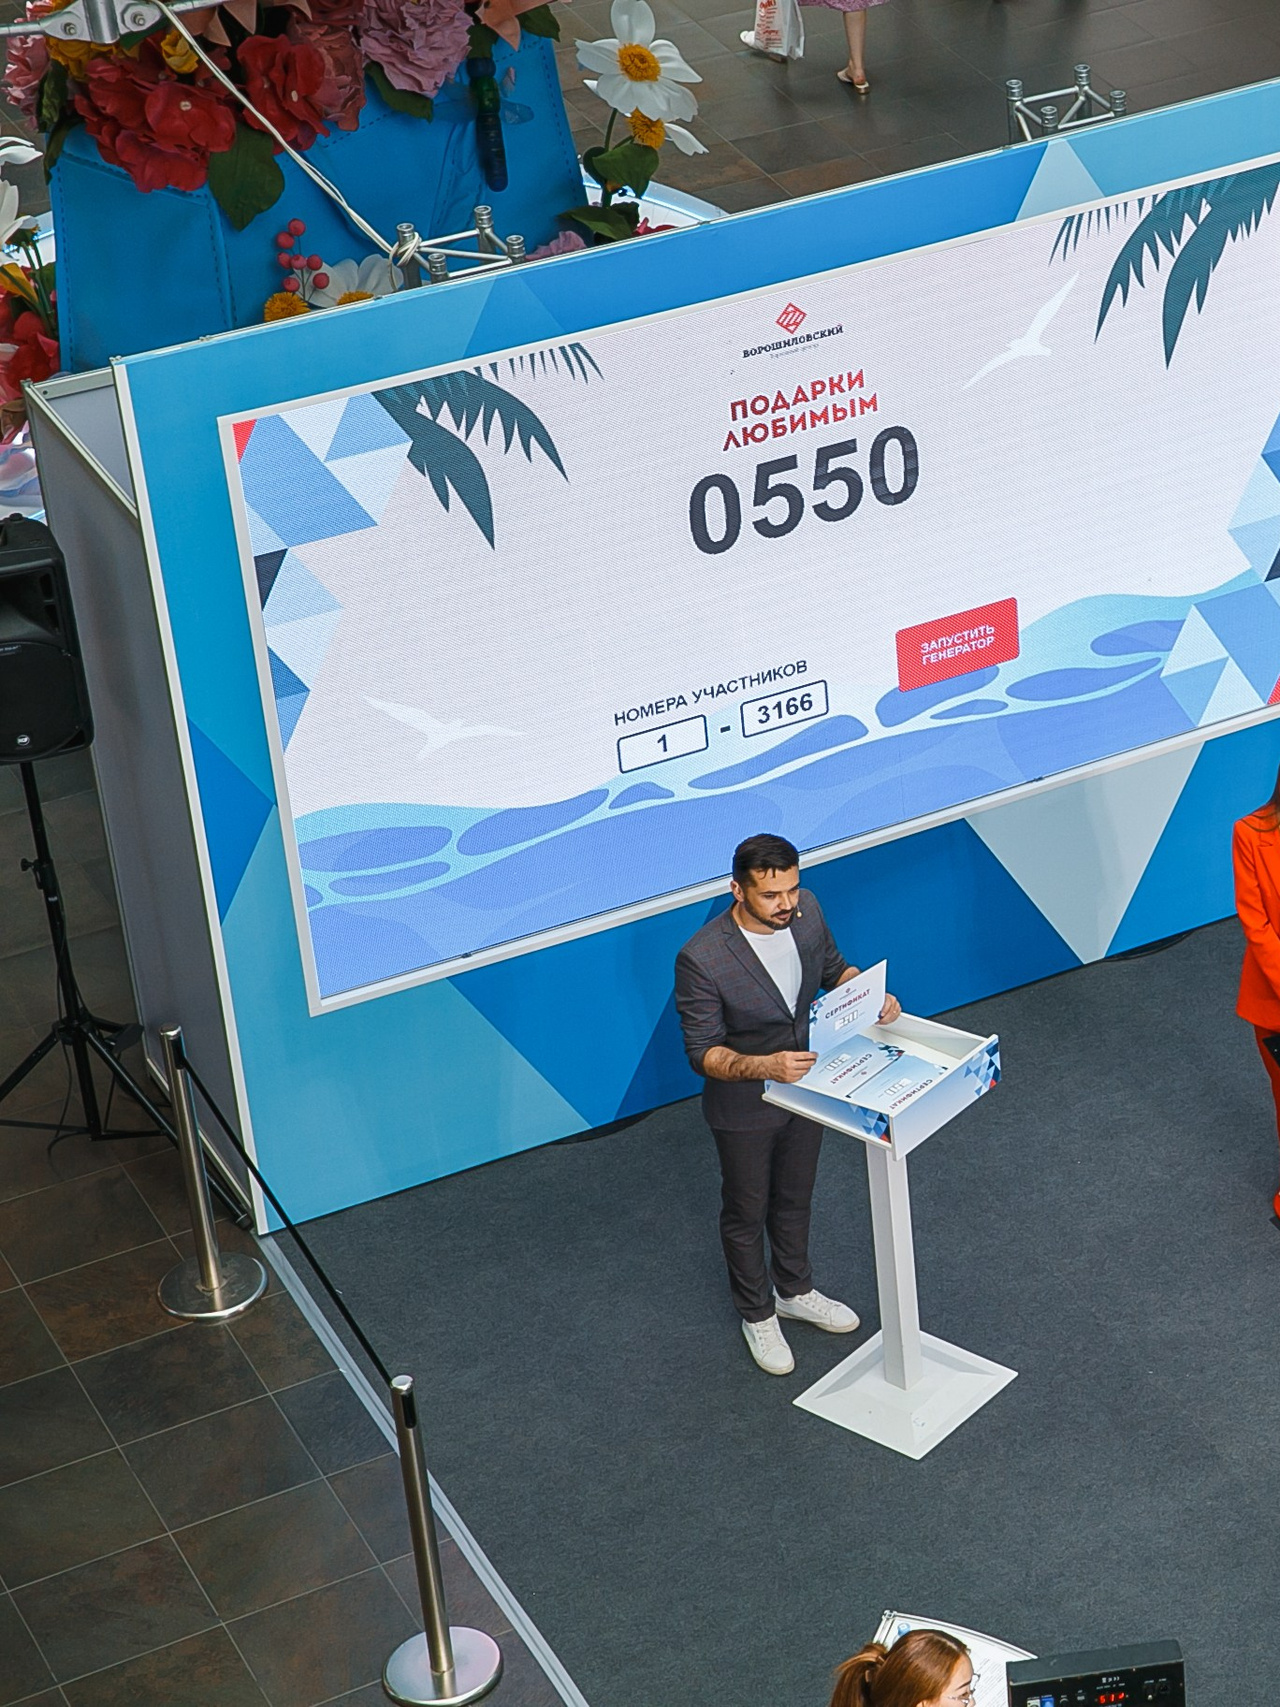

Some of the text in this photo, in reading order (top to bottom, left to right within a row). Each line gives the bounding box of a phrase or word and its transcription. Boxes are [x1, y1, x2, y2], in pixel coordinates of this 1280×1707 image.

[742, 323, 844, 358] ВОРОШИЛОВСКИЙ
[730, 369, 865, 421] ПОДАРКИ
[722, 392, 879, 452] ЛЮБИМЫМ
[688, 425, 921, 555] 0550
[920, 624, 995, 654] ЗАПУСТИТЬ
[922, 636, 995, 666] ГЕНЕРАТОР
[614, 659, 808, 726] НОМЕРА УЧАСТНИКОВ
[656, 734, 669, 753] 1
[757, 693, 814, 725] 3166
[825, 988, 870, 1019] СЕРТИФИКАТ
[829, 1053, 872, 1084] СЕРТИФИКАТ
[888, 1078, 933, 1110] СЕРТИФИКАТ
